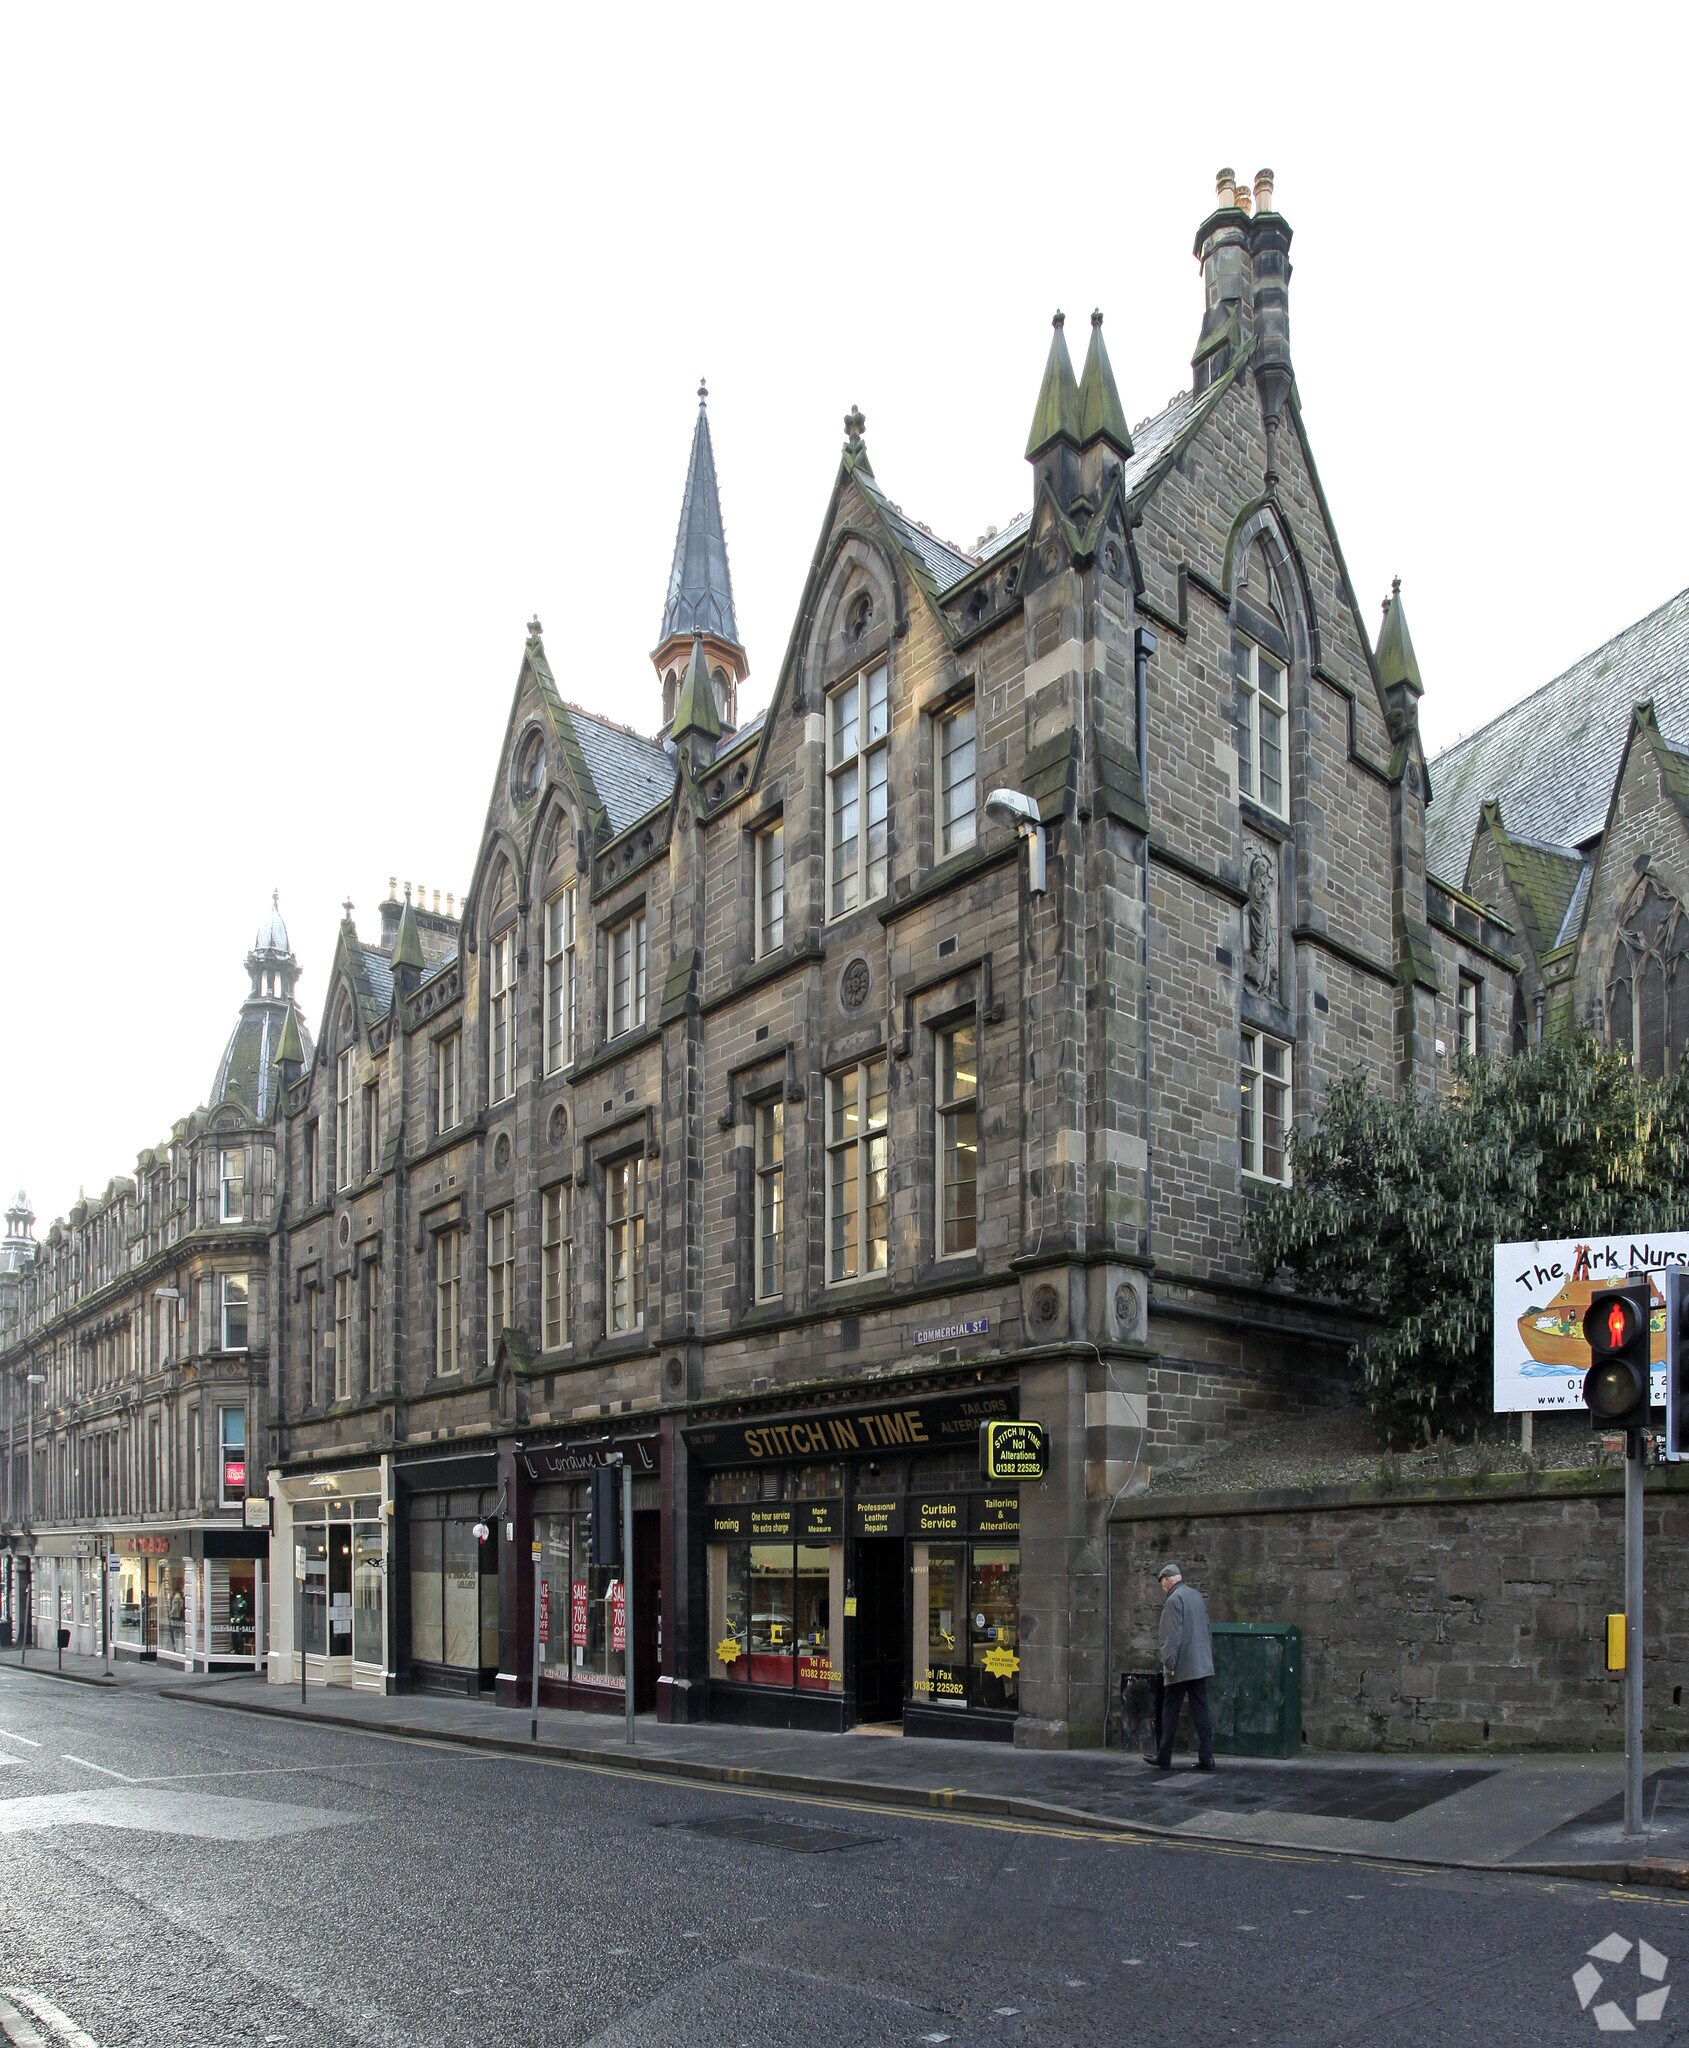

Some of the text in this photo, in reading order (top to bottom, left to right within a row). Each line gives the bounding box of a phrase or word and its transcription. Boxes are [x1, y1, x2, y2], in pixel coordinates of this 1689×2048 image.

[1516, 1243, 1689, 1291] The Ark Nurs
[917, 1323, 969, 1342] COMMERCIAL
[960, 1400, 1007, 1415] TAILORS
[744, 1410, 929, 1458] STITCH IN TIME
[994, 1427, 1041, 1449] STITCH IN TIME
[1012, 1439, 1026, 1449] No1
[545, 1449, 597, 1471] Lorraine
[1000, 1450, 1036, 1460] Alterations
[995, 1463, 1041, 1473] 01382 225262
[857, 1502, 896, 1512] Professional
[921, 1503, 956, 1515] Curtain
[984, 1499, 1018, 1510] Tailoring
[751, 1511, 791, 1521] One hour service
[812, 1507, 828, 1515] Made
[997, 1510, 1004, 1519] &
[816, 1516, 824, 1524] To
[864, 1513, 888, 1522] Leather
[714, 1518, 740, 1532] Ironing
[752, 1523, 789, 1534] No extra charge
[808, 1525, 832, 1533] Measure
[864, 1523, 888, 1533] Repairs
[920, 1518, 957, 1529] Service
[573, 1584, 587, 1600] SALE
[613, 1586, 625, 1602] SAL
[573, 1606, 587, 1623] 70%
[573, 1623, 587, 1632] OFF
[809, 1657, 818, 1667] Tel
[800, 1668, 842, 1681] 01382 225262
[924, 1668, 935, 1679] Tel
[914, 1680, 964, 1694] 01382 225262
